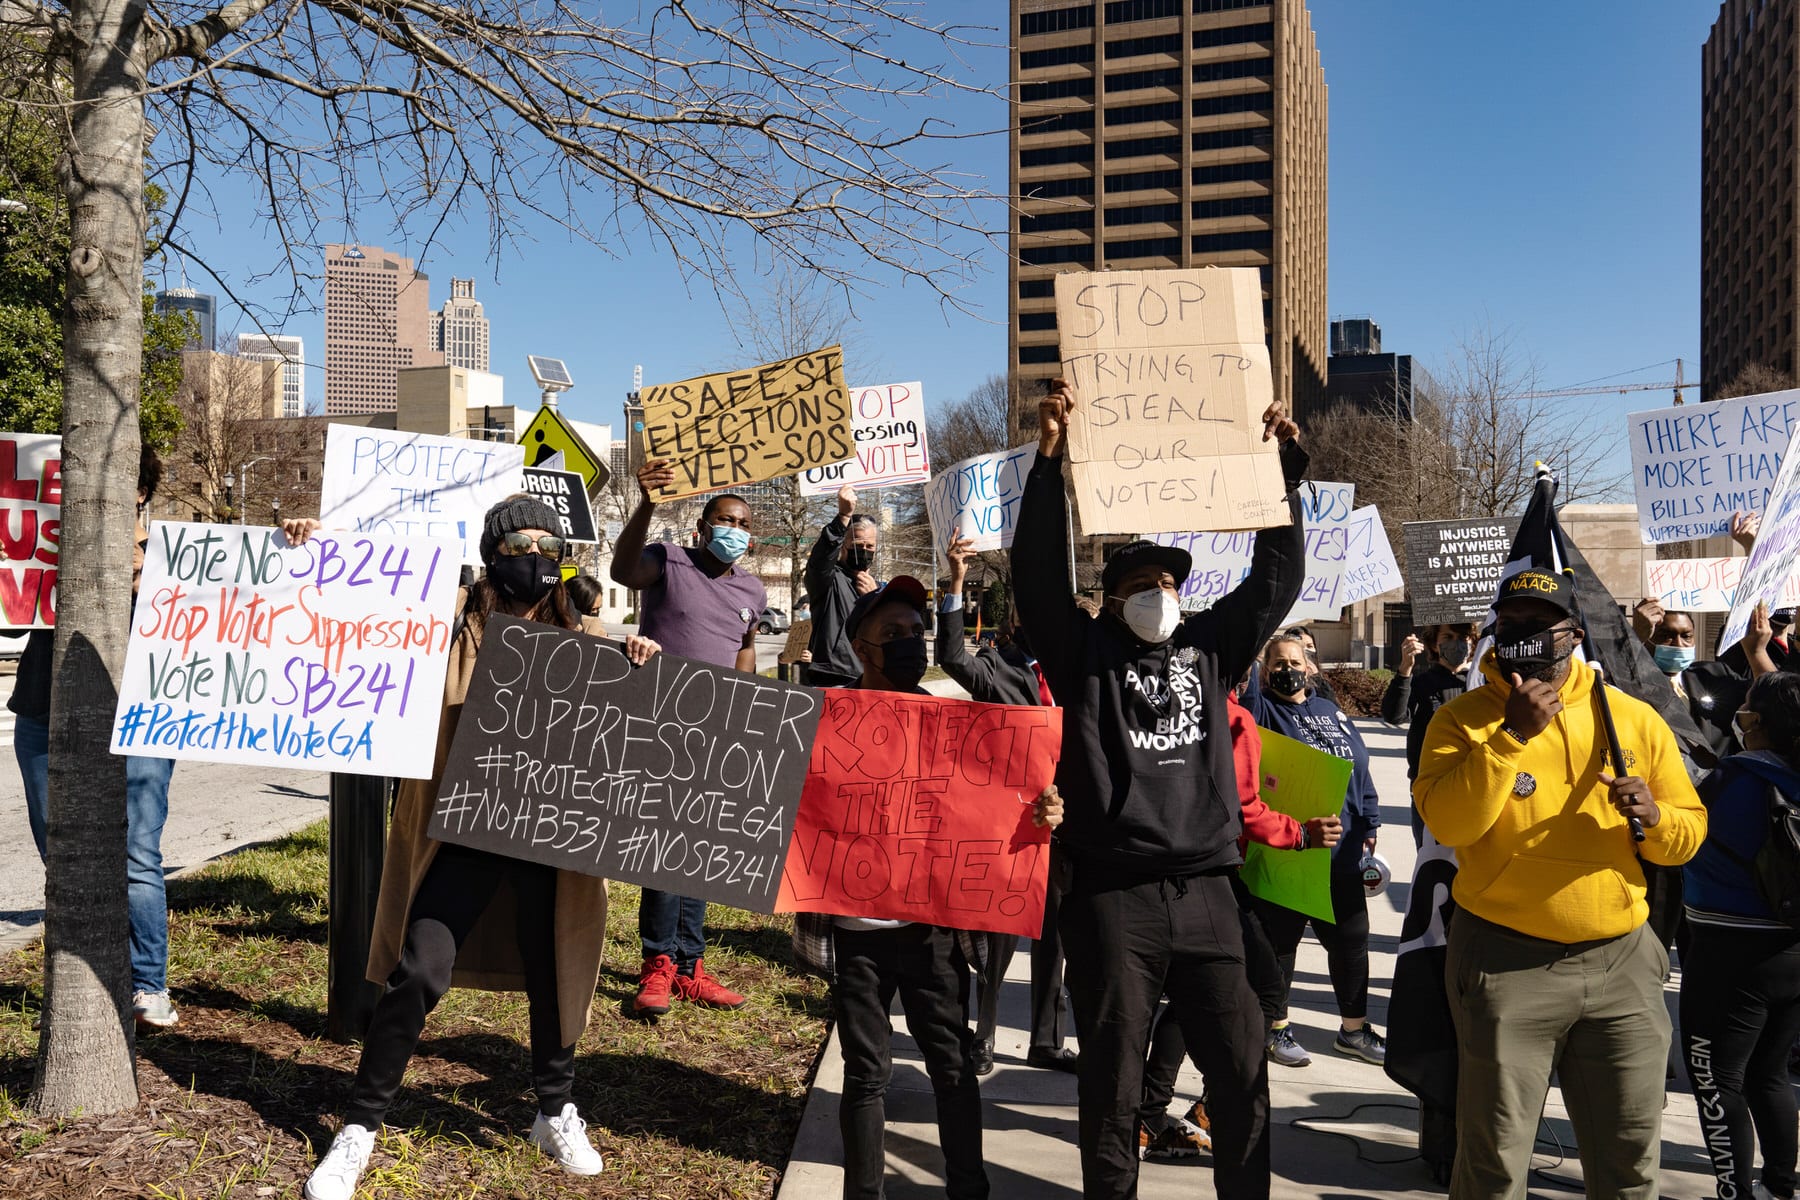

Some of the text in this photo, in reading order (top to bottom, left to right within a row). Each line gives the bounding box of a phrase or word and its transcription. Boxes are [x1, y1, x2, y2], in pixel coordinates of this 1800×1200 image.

[1072, 281, 1206, 338] STOP
[1061, 353, 1194, 390] TRYING
[849, 384, 910, 420] OP
[1090, 394, 1234, 427] STEAL
[649, 388, 846, 458] ELECTIONS
[851, 419, 918, 448] essing
[1639, 410, 1727, 454] THERE
[353, 436, 496, 486] PROTECT
[856, 432, 929, 475] VOTE!
[0, 440, 62, 505] LE
[1096, 469, 1217, 510] VOTES!
[1644, 456, 1713, 489] MORE
[391, 487, 442, 513] THE
[971, 496, 1023, 534] VOT
[1302, 488, 1350, 524] NDS
[1651, 494, 1705, 521] BILLS
[1304, 527, 1349, 561] TES!
[1439, 526, 1507, 541] INJUSTICE
[1439, 539, 1511, 554] ANYWHERE
[1647, 518, 1729, 543] SUPPRESSING
[162, 525, 441, 602] Vote No SB241
[1428, 553, 1504, 569] IS A THREAT
[1179, 596, 1210, 611] otect
[1299, 573, 1340, 608] 241
[1434, 580, 1500, 595] EVERYWH
[1510, 578, 1558, 593] NAACP
[1661, 588, 1703, 608] THE
[139, 584, 449, 677] Stop Voter Suppression
[149, 648, 415, 719] Vote No SB241
[489, 625, 815, 752] STOP VOTER
[1155, 704, 1202, 734] BLAC
[477, 688, 785, 804] SUPPRESSION
[810, 697, 1048, 788] ROTECT
[837, 779, 949, 835] THE
[618, 825, 778, 896] #NOSB241
[784, 830, 1040, 916] VOTE!
[1691, 1035, 1717, 1090] KLEIN
[1706, 1125, 1737, 1200] CALVIN
